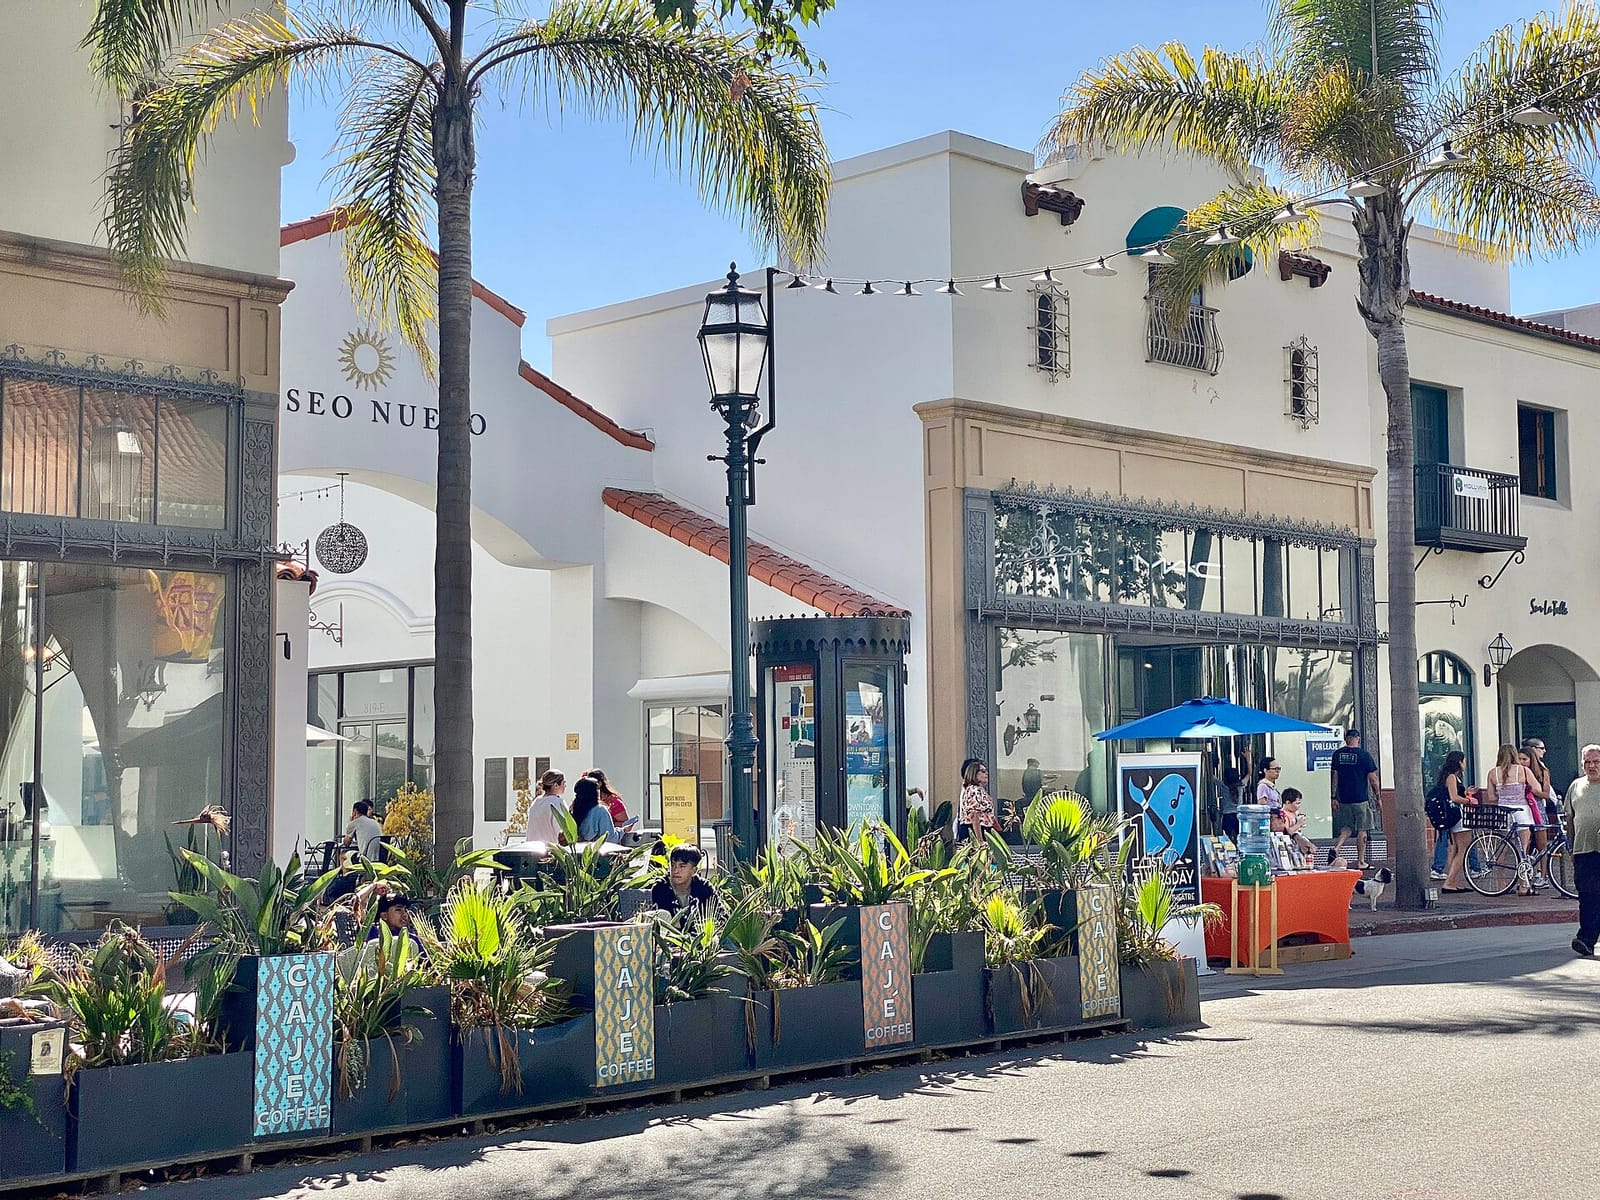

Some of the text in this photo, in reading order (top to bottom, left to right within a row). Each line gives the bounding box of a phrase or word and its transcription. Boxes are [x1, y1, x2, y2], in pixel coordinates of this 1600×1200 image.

[371, 399, 487, 436] NUEO
[1083, 995, 1119, 1011] COFFEE
[286, 963, 307, 1098] CAJE
[866, 1022, 912, 1040] COFFEE
[598, 1058, 653, 1078] COFFEE
[257, 1104, 328, 1126] COFFEE
